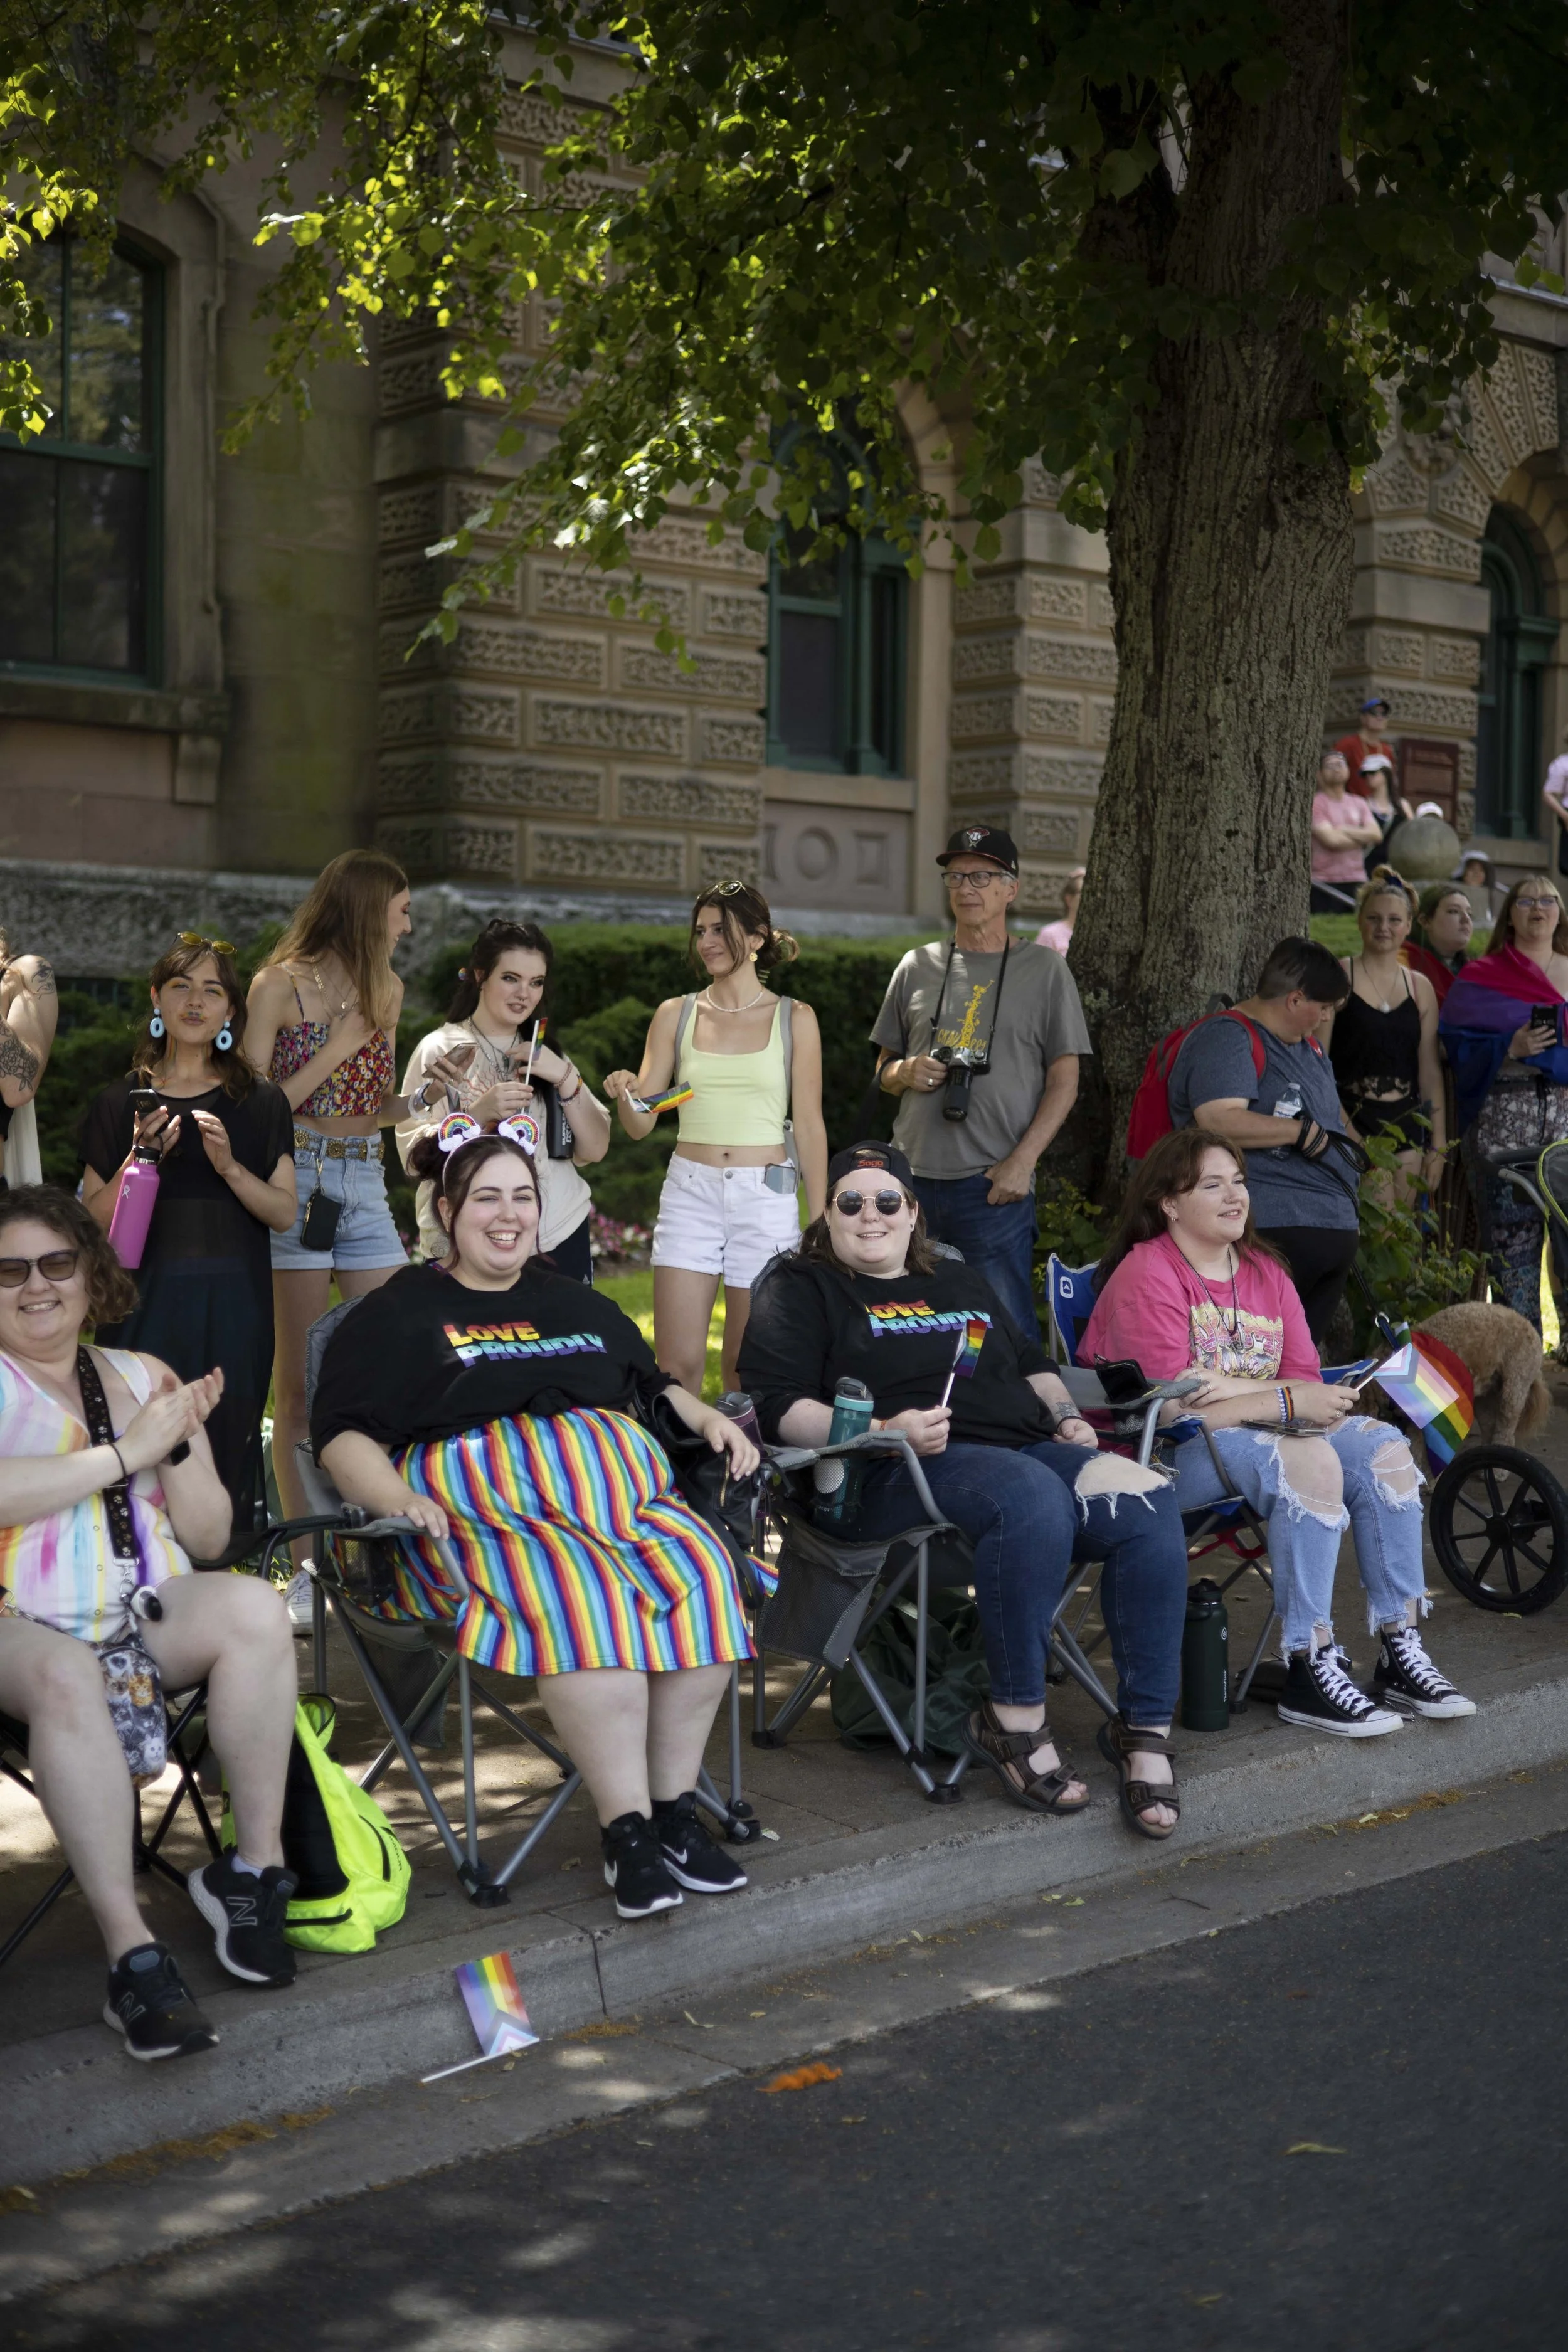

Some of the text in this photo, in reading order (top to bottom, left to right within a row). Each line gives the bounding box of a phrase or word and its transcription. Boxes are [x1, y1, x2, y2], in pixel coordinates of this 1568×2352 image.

[864, 1300, 935, 1318] OVE
[443, 1321, 540, 1347] LOVE
[455, 1333, 608, 1368] PROUDLY
[226, 1896, 258, 1927] N
